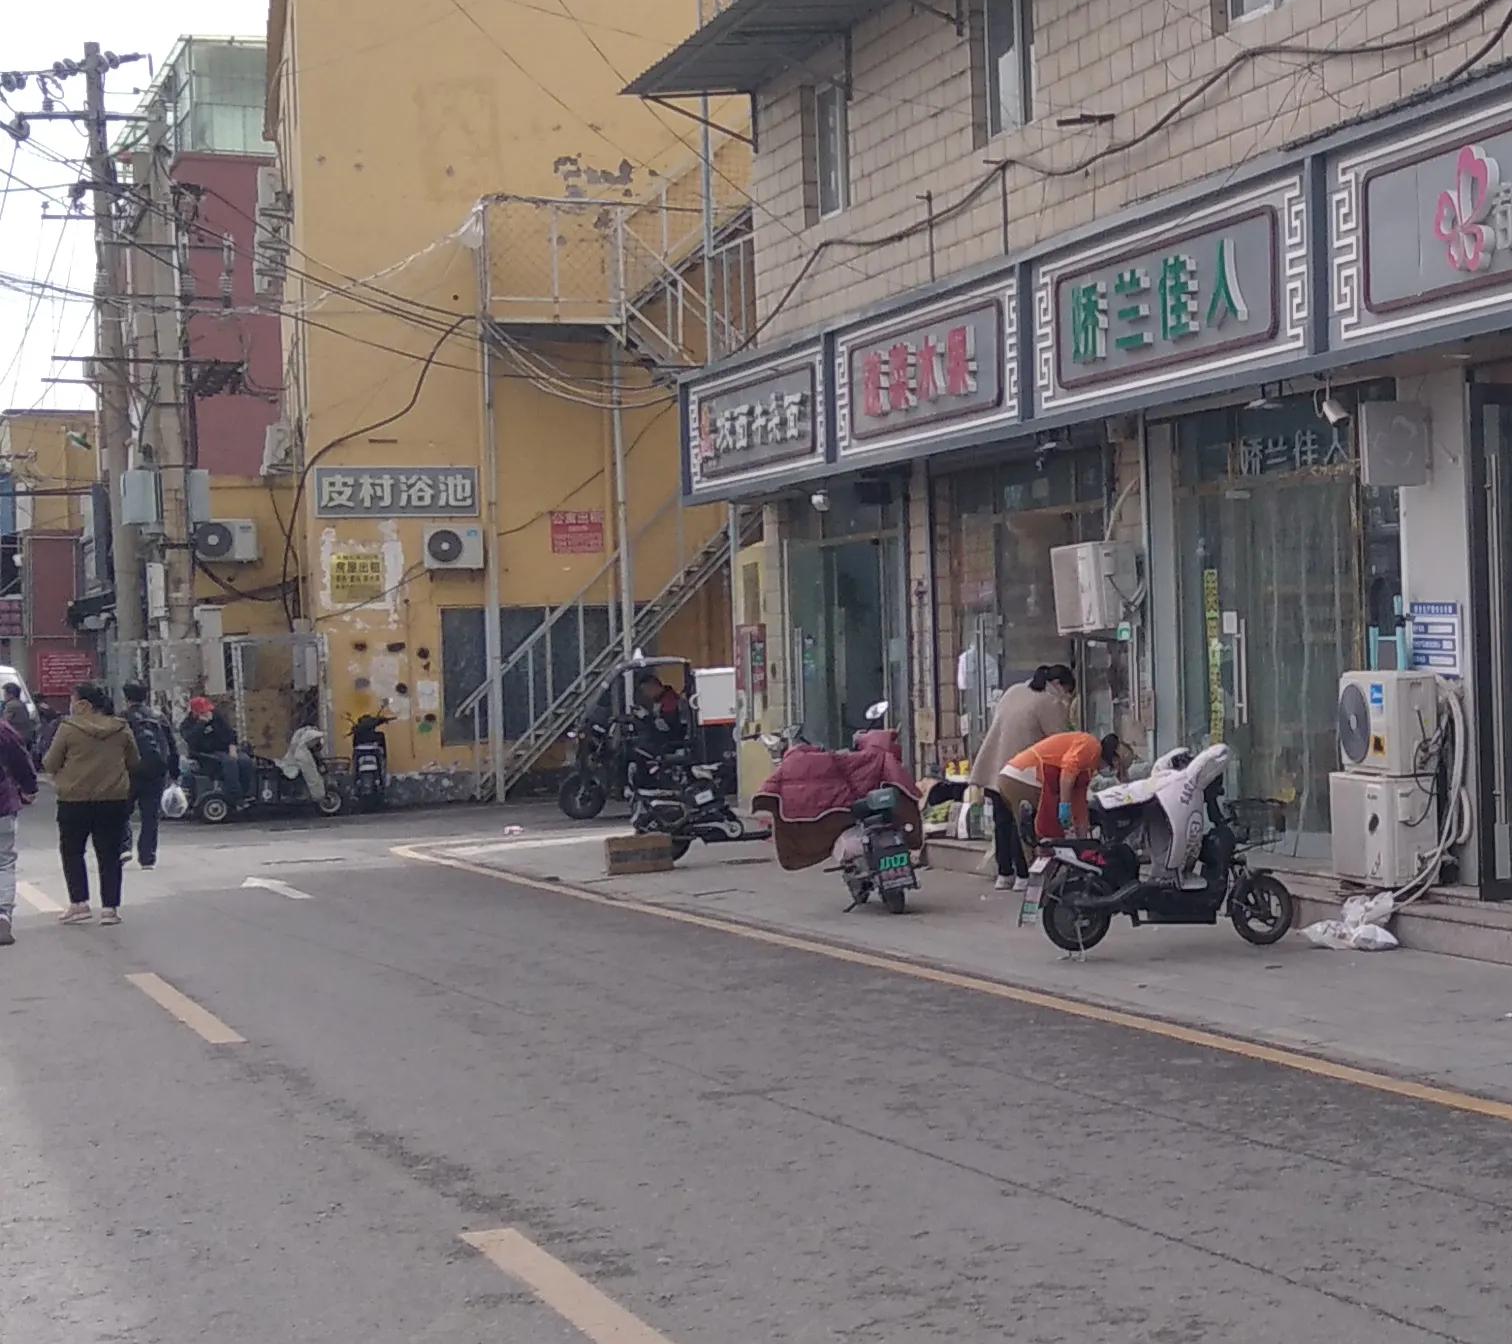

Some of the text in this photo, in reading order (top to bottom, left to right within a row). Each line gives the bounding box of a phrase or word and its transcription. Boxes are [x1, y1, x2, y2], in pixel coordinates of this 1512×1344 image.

[1072, 237, 1249, 364] 娇兰佳人
[321, 474, 473, 508] 皮村浴池
